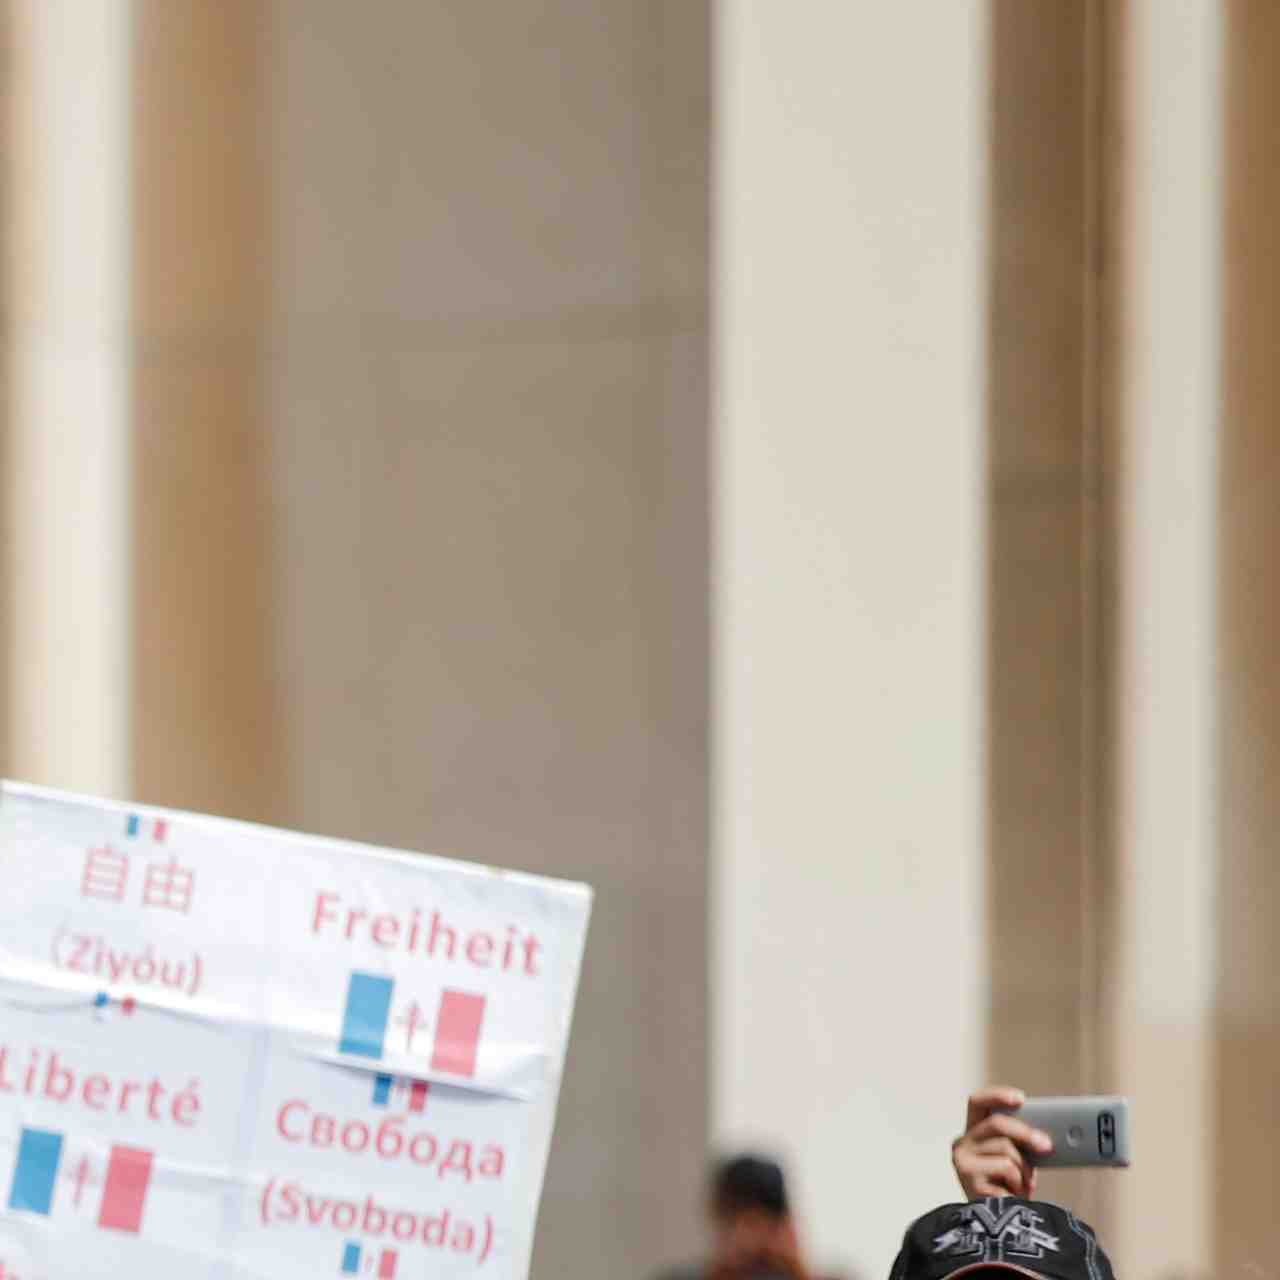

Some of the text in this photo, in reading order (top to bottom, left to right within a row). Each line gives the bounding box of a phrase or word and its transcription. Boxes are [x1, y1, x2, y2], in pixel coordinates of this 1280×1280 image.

[78, 844, 194, 913] 自由
[310, 891, 543, 978] Freiheit
[275, 1099, 506, 1180] Свобода
[258, 1180, 496, 1265] (Svoboda)
